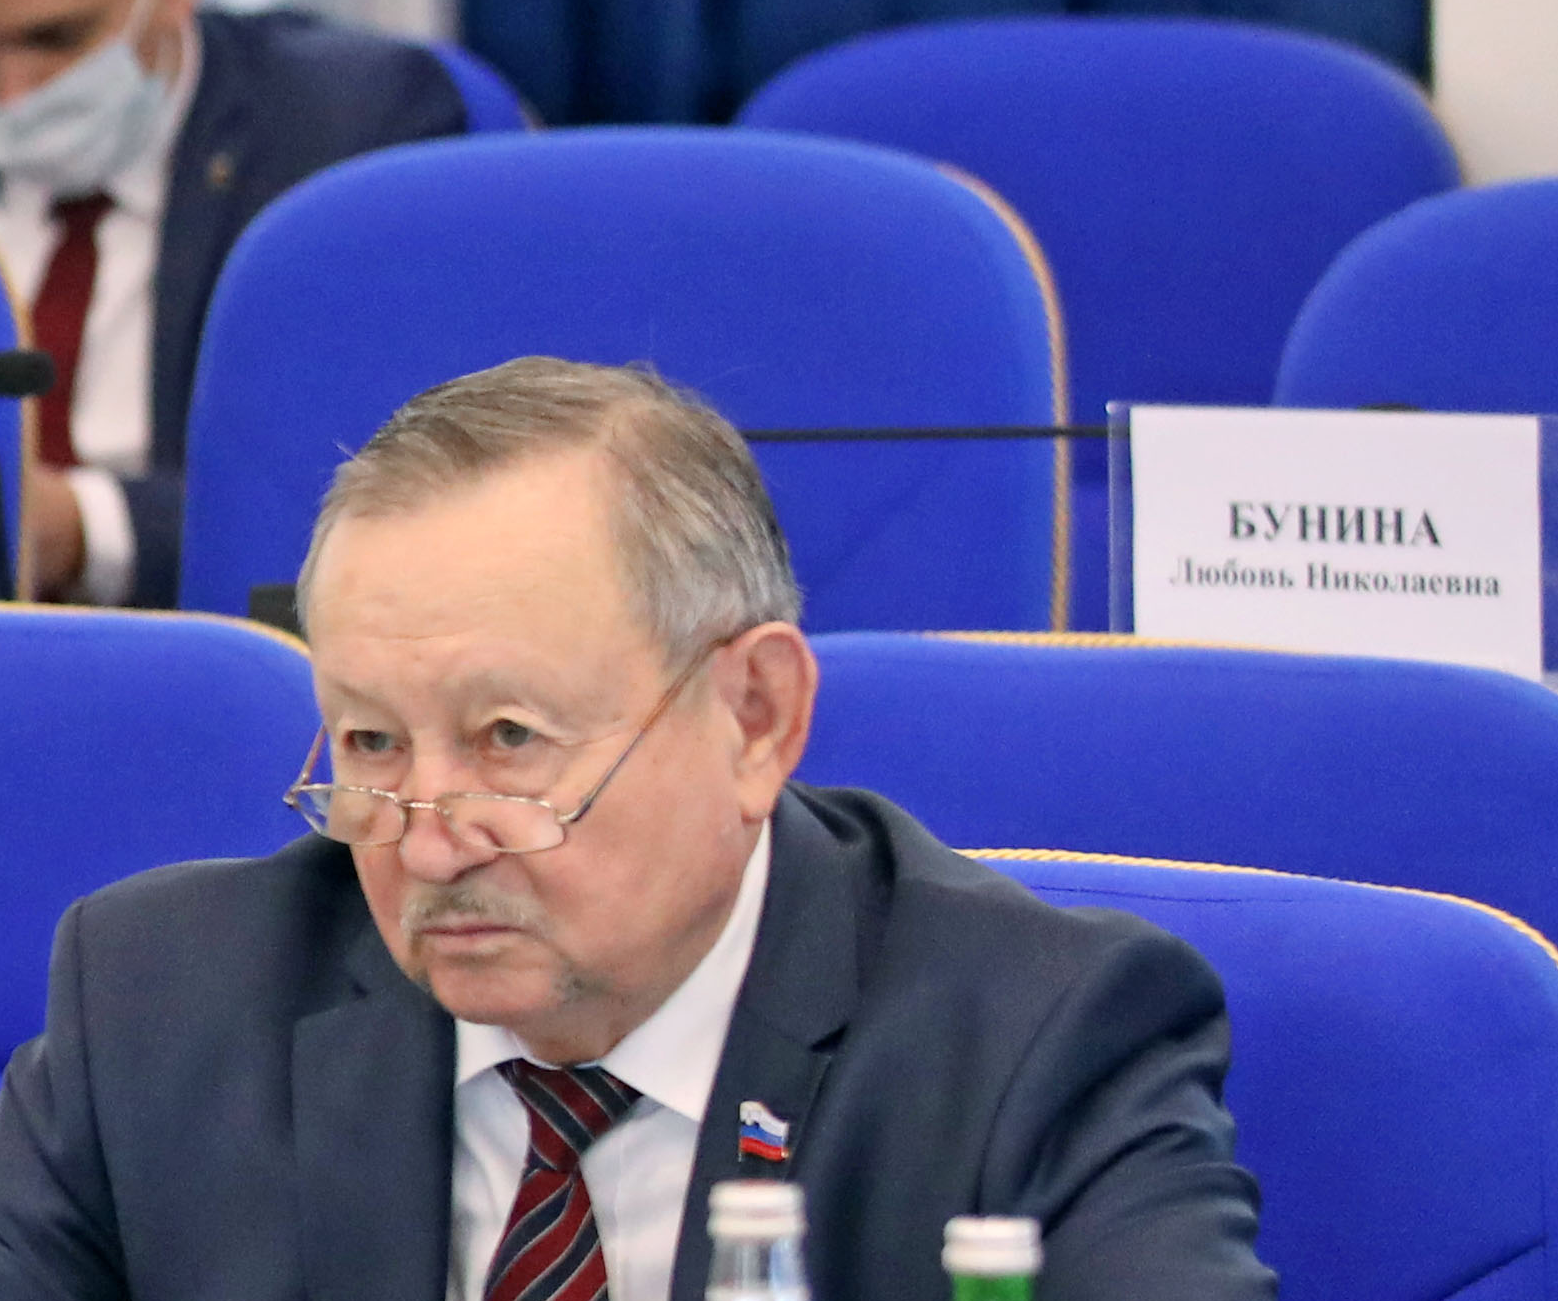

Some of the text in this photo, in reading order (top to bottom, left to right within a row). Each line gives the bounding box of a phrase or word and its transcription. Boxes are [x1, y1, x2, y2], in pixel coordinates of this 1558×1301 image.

[1229, 502, 1442, 547] БУНИНА
[1170, 557, 1501, 597] Любовь Николаевна
